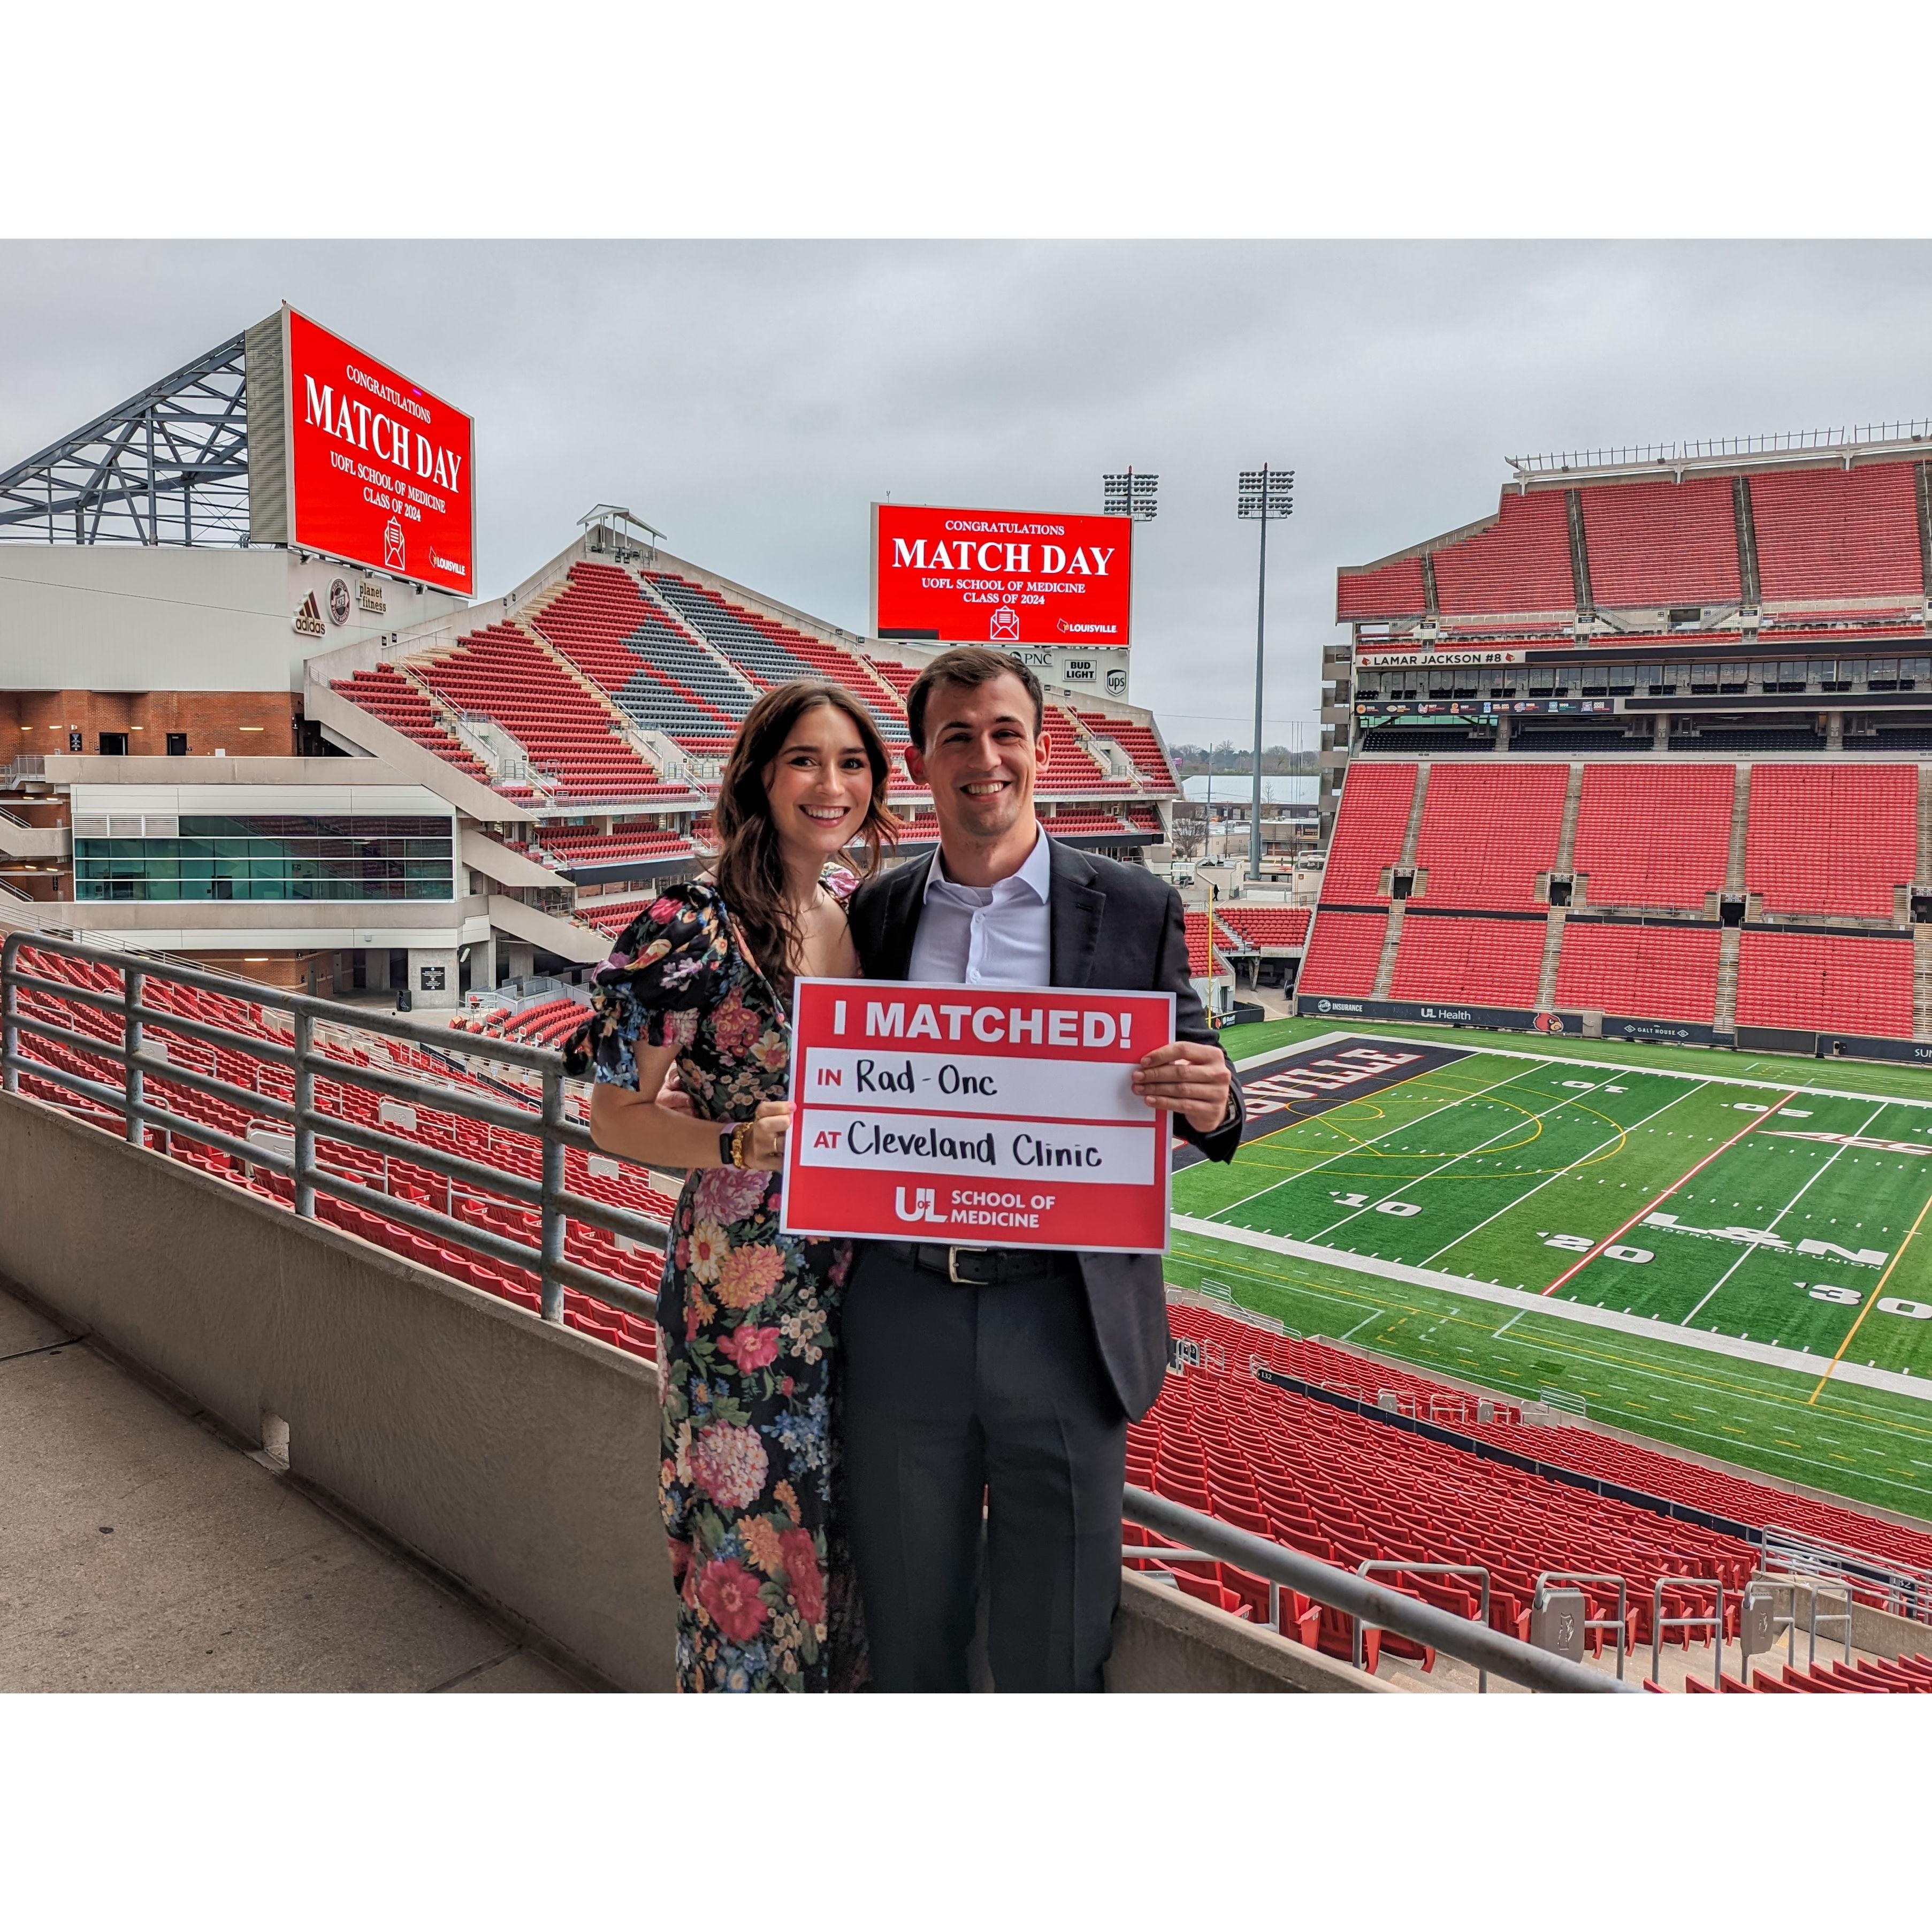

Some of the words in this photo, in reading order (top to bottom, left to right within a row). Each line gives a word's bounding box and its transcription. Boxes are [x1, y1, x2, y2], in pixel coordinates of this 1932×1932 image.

[346, 364, 431, 424] CONGRATULATIONS
[304, 373, 411, 471] MATCH
[415, 433, 462, 493] DAY
[330, 450, 356, 476] UOFL
[357, 463, 393, 491] SCHOOL
[395, 480, 406, 496] OF
[408, 485, 446, 514] MEDICINE
[363, 486, 391, 510] CLASS
[392, 498, 403, 514] OF
[404, 503, 421, 522] 2024
[945, 520, 1065, 536] CONGRATULATIONS
[892, 538, 1031, 572] MATCH
[1041, 545, 1114, 575] DAY
[437, 556, 465, 576] LOUISVILLE
[360, 583, 383, 599] planet
[922, 577, 953, 589] UOFL
[956, 579, 1005, 590] SCHOOL
[1007, 581, 1024, 591] OF
[1026, 582, 1086, 593] MEDICINE
[363, 597, 386, 612] fitness
[963, 592, 999, 603] CLASS
[1002, 593, 1018, 604] OF
[1021, 594, 1045, 605] 2024
[296, 616, 325, 635] adidas
[1070, 624, 1117, 633] LOUISVILLE
[1024, 653, 1052, 665] PNC
[1374, 655, 1417, 666] LAMAR
[1421, 654, 1482, 665] JACKSON
[1485, 653, 1501, 663] #8
[1109, 677, 1125, 690] ups
[1332, 1003, 1363, 1012] INSURANCE
[1439, 1009, 1471, 1020] Health
[833, 999, 847, 1035] I
[866, 1002, 1132, 1049] MATCHED!
[817, 1068, 842, 1087] IN
[814, 1131, 842, 1149] AT
[847, 1120, 996, 1166] Cleveland
[1013, 1134, 1102, 1167] Clinic
[951, 1190, 1026, 1209] SCHOOL
[1030, 1195, 1056, 1210] OF
[951, 1209, 1040, 1228] MEDICINE
[1638, 1223, 1725, 1242] FEDERAL
[1260, 1371, 1273, 1381] 132
